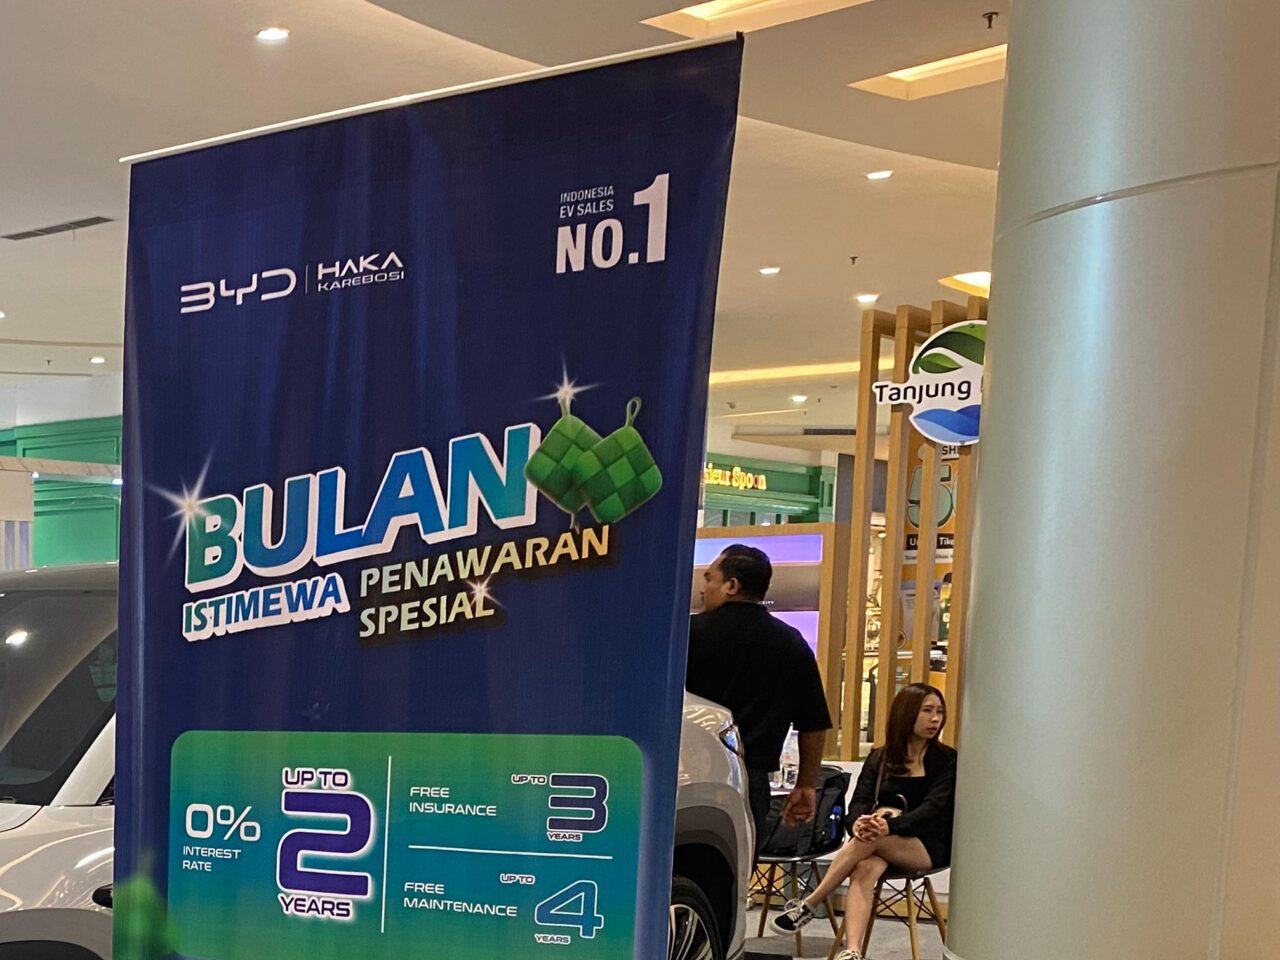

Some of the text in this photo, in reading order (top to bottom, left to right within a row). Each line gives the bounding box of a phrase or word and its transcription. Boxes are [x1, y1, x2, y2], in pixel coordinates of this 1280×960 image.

[560, 185, 614, 203] INDONESIA
[560, 199, 614, 219] EV SALES
[317, 251, 404, 279] HAKA
[181, 268, 297, 314] BYD
[318, 271, 404, 292] KAREBOSI
[875, 380, 971, 404] Tanjung
[732, 467, 767, 490] Spoon
[186, 424, 538, 590] BULAN
[360, 525, 609, 598] PENAWARAN
[184, 575, 346, 637] ISTIMEWA
[359, 589, 495, 638] SPESIAL
[284, 769, 349, 787] UP TO
[410, 786, 450, 798] FREE
[512, 773, 609, 833] UP TO 3
[409, 802, 497, 817] INSURANCE
[185, 803, 261, 842] 0%
[277, 789, 374, 896] 2
[547, 832, 582, 842] YEARS
[182, 845, 241, 859] INTEREST
[182, 860, 212, 871] RATE
[404, 882, 445, 894] FREE
[500, 873, 535, 885] UP TO
[279, 895, 351, 918] YEARS
[403, 897, 518, 917] MAINTENANCE
[535, 879, 604, 939] 4
[535, 934, 570, 944] YEARS
